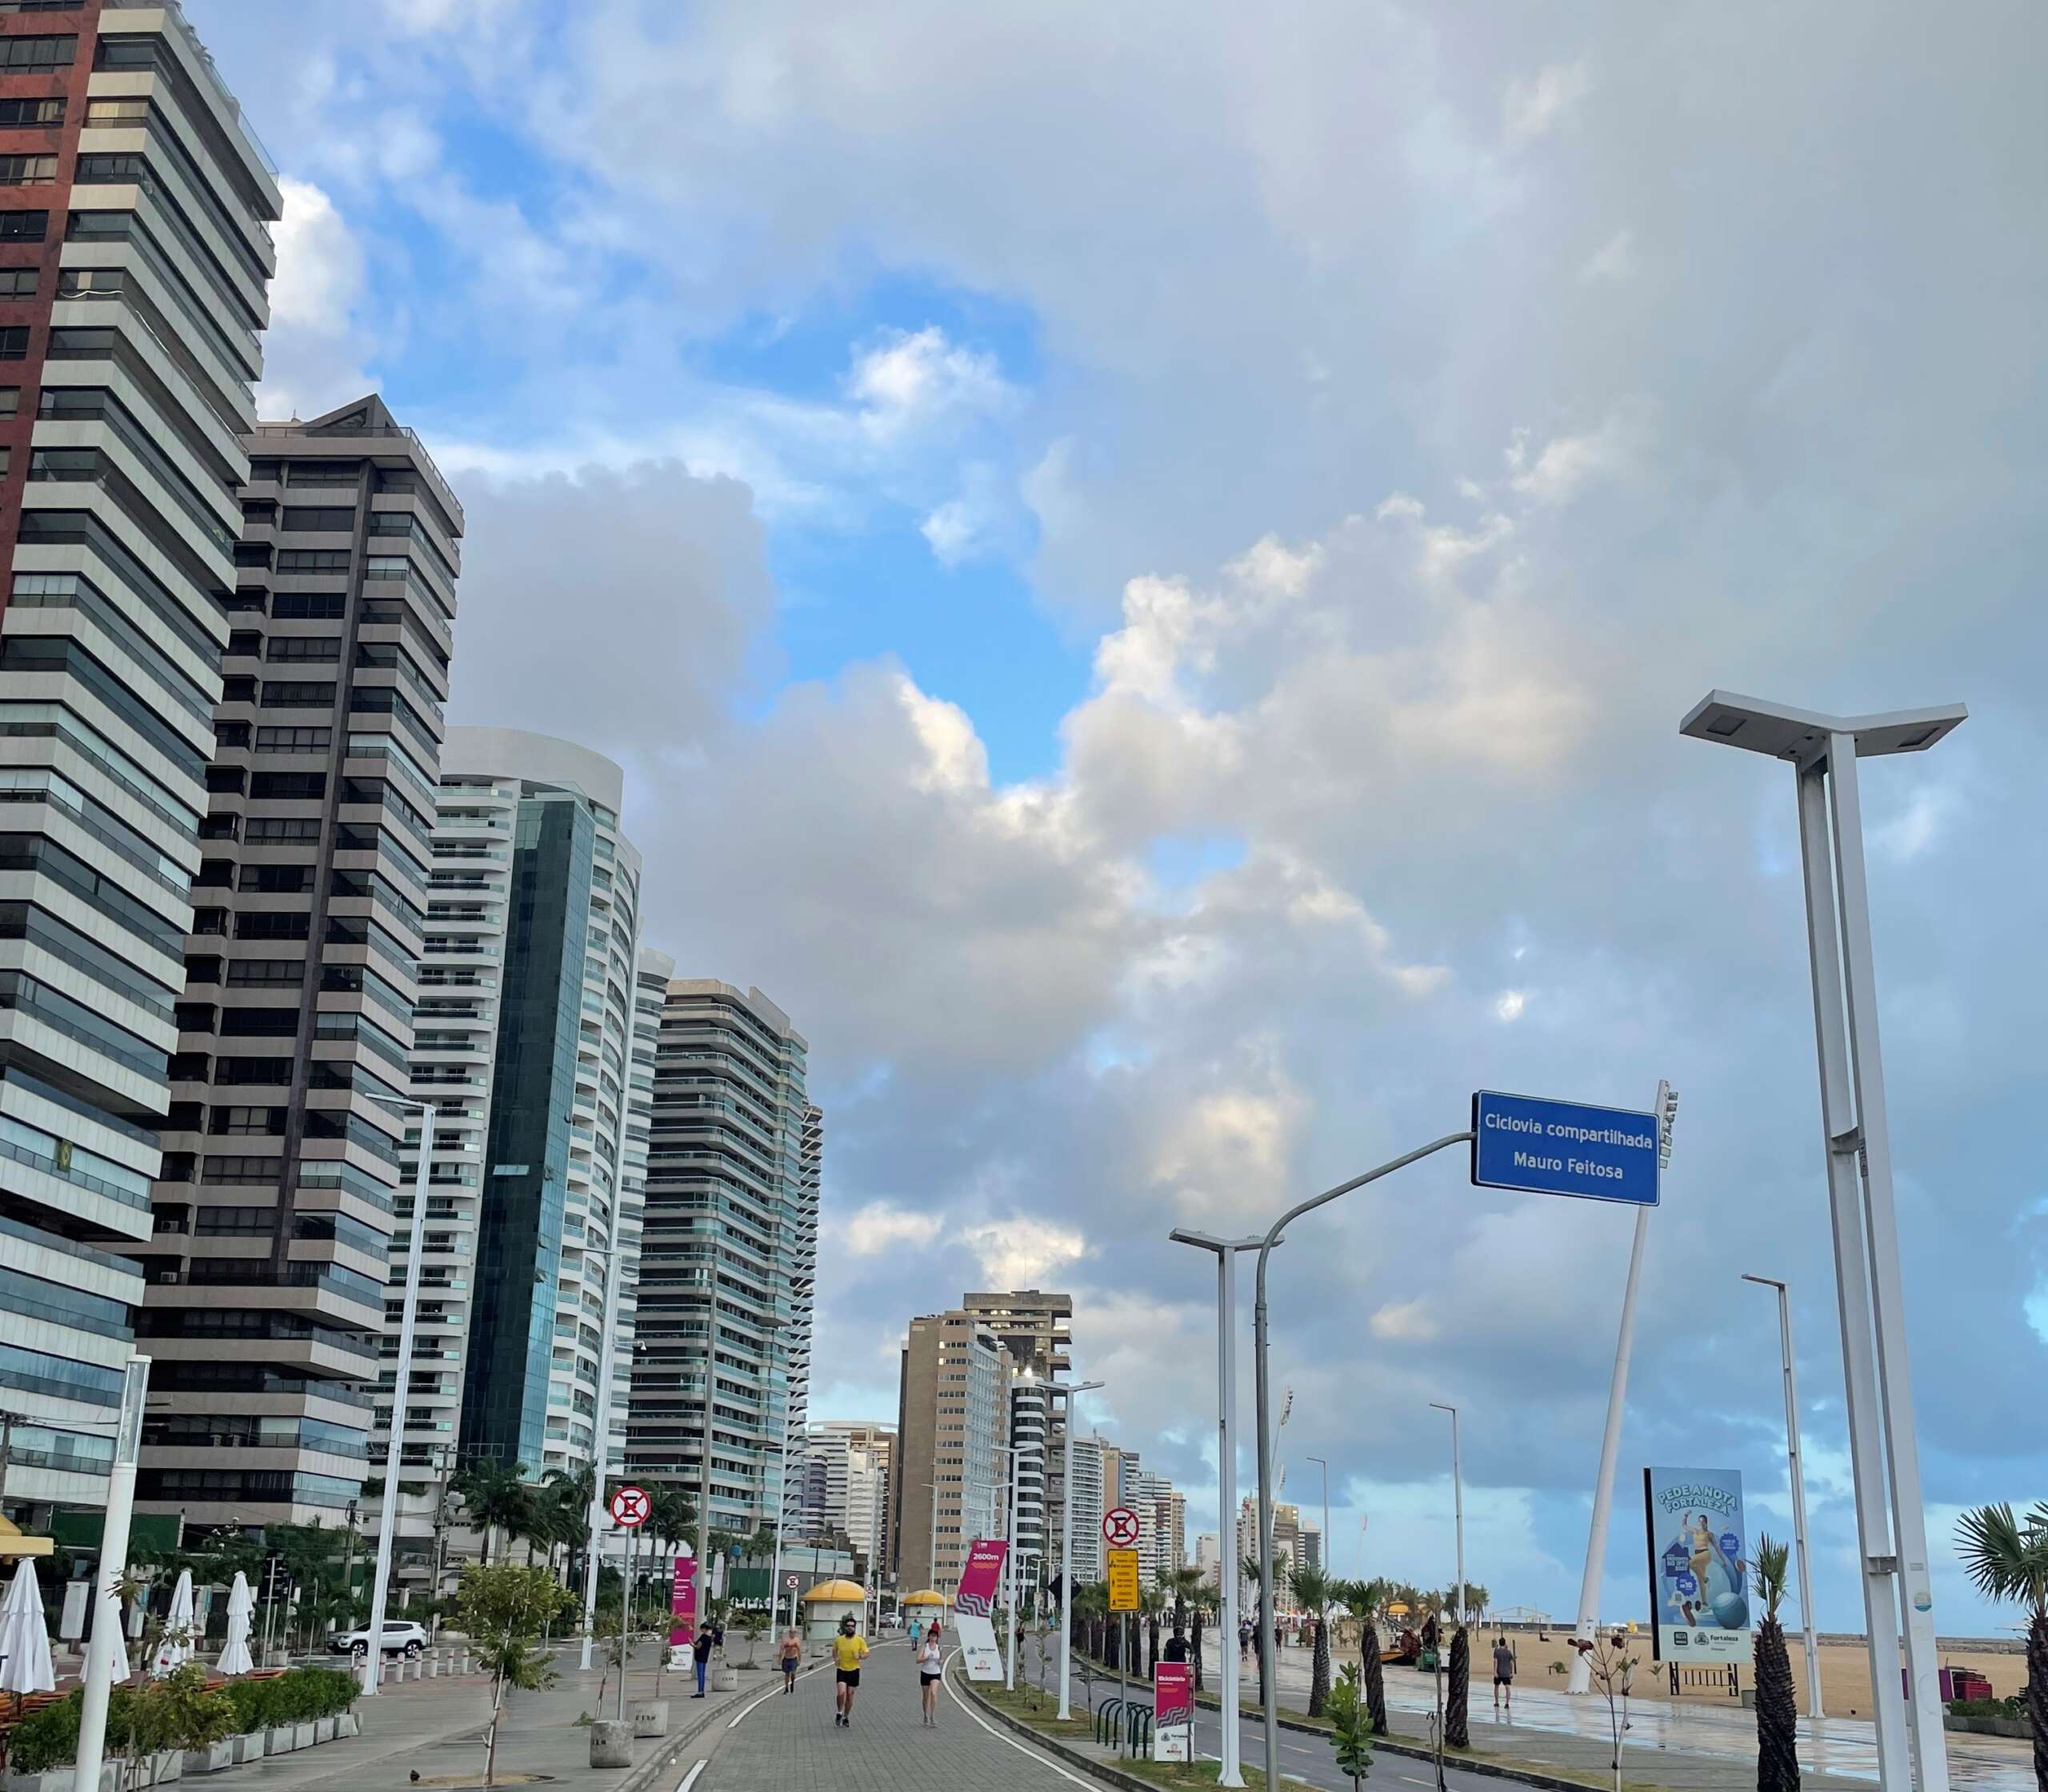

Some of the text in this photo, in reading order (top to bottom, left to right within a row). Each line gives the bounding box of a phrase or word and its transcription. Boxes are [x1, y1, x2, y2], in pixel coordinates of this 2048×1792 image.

[1485, 1113, 1653, 1149] Ciclovia compartilhada
[1514, 1151, 1623, 1179] Mauro Feitosa
[1658, 1486, 1690, 1505] PEDE
[1693, 1485, 1702, 1496] A
